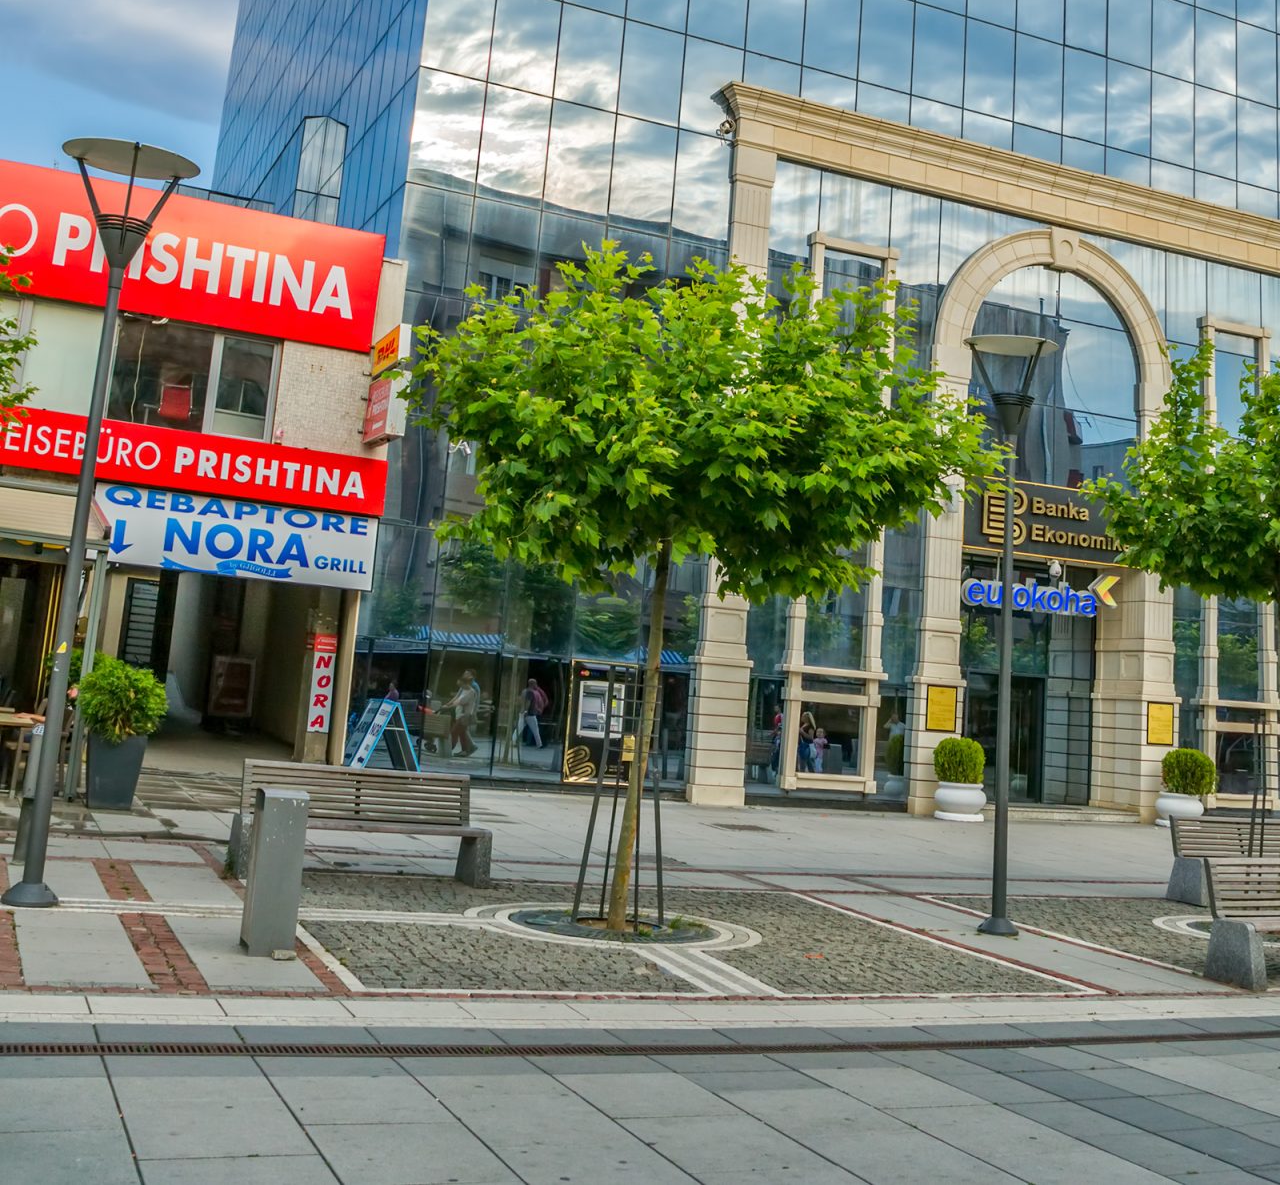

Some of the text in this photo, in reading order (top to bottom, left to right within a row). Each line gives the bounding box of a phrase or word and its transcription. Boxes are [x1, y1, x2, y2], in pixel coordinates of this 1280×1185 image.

[52, 212, 352, 320] PISHTINA
[0, 422, 365, 500] EISEBÜRO PRISHTINA
[105, 486, 369, 536] QEBAPTORE
[1031, 497, 1090, 521] Banka
[163, 517, 367, 574] NORA GRILL
[965, 581, 1097, 616] euokoha
[310, 655, 332, 728] NORA
